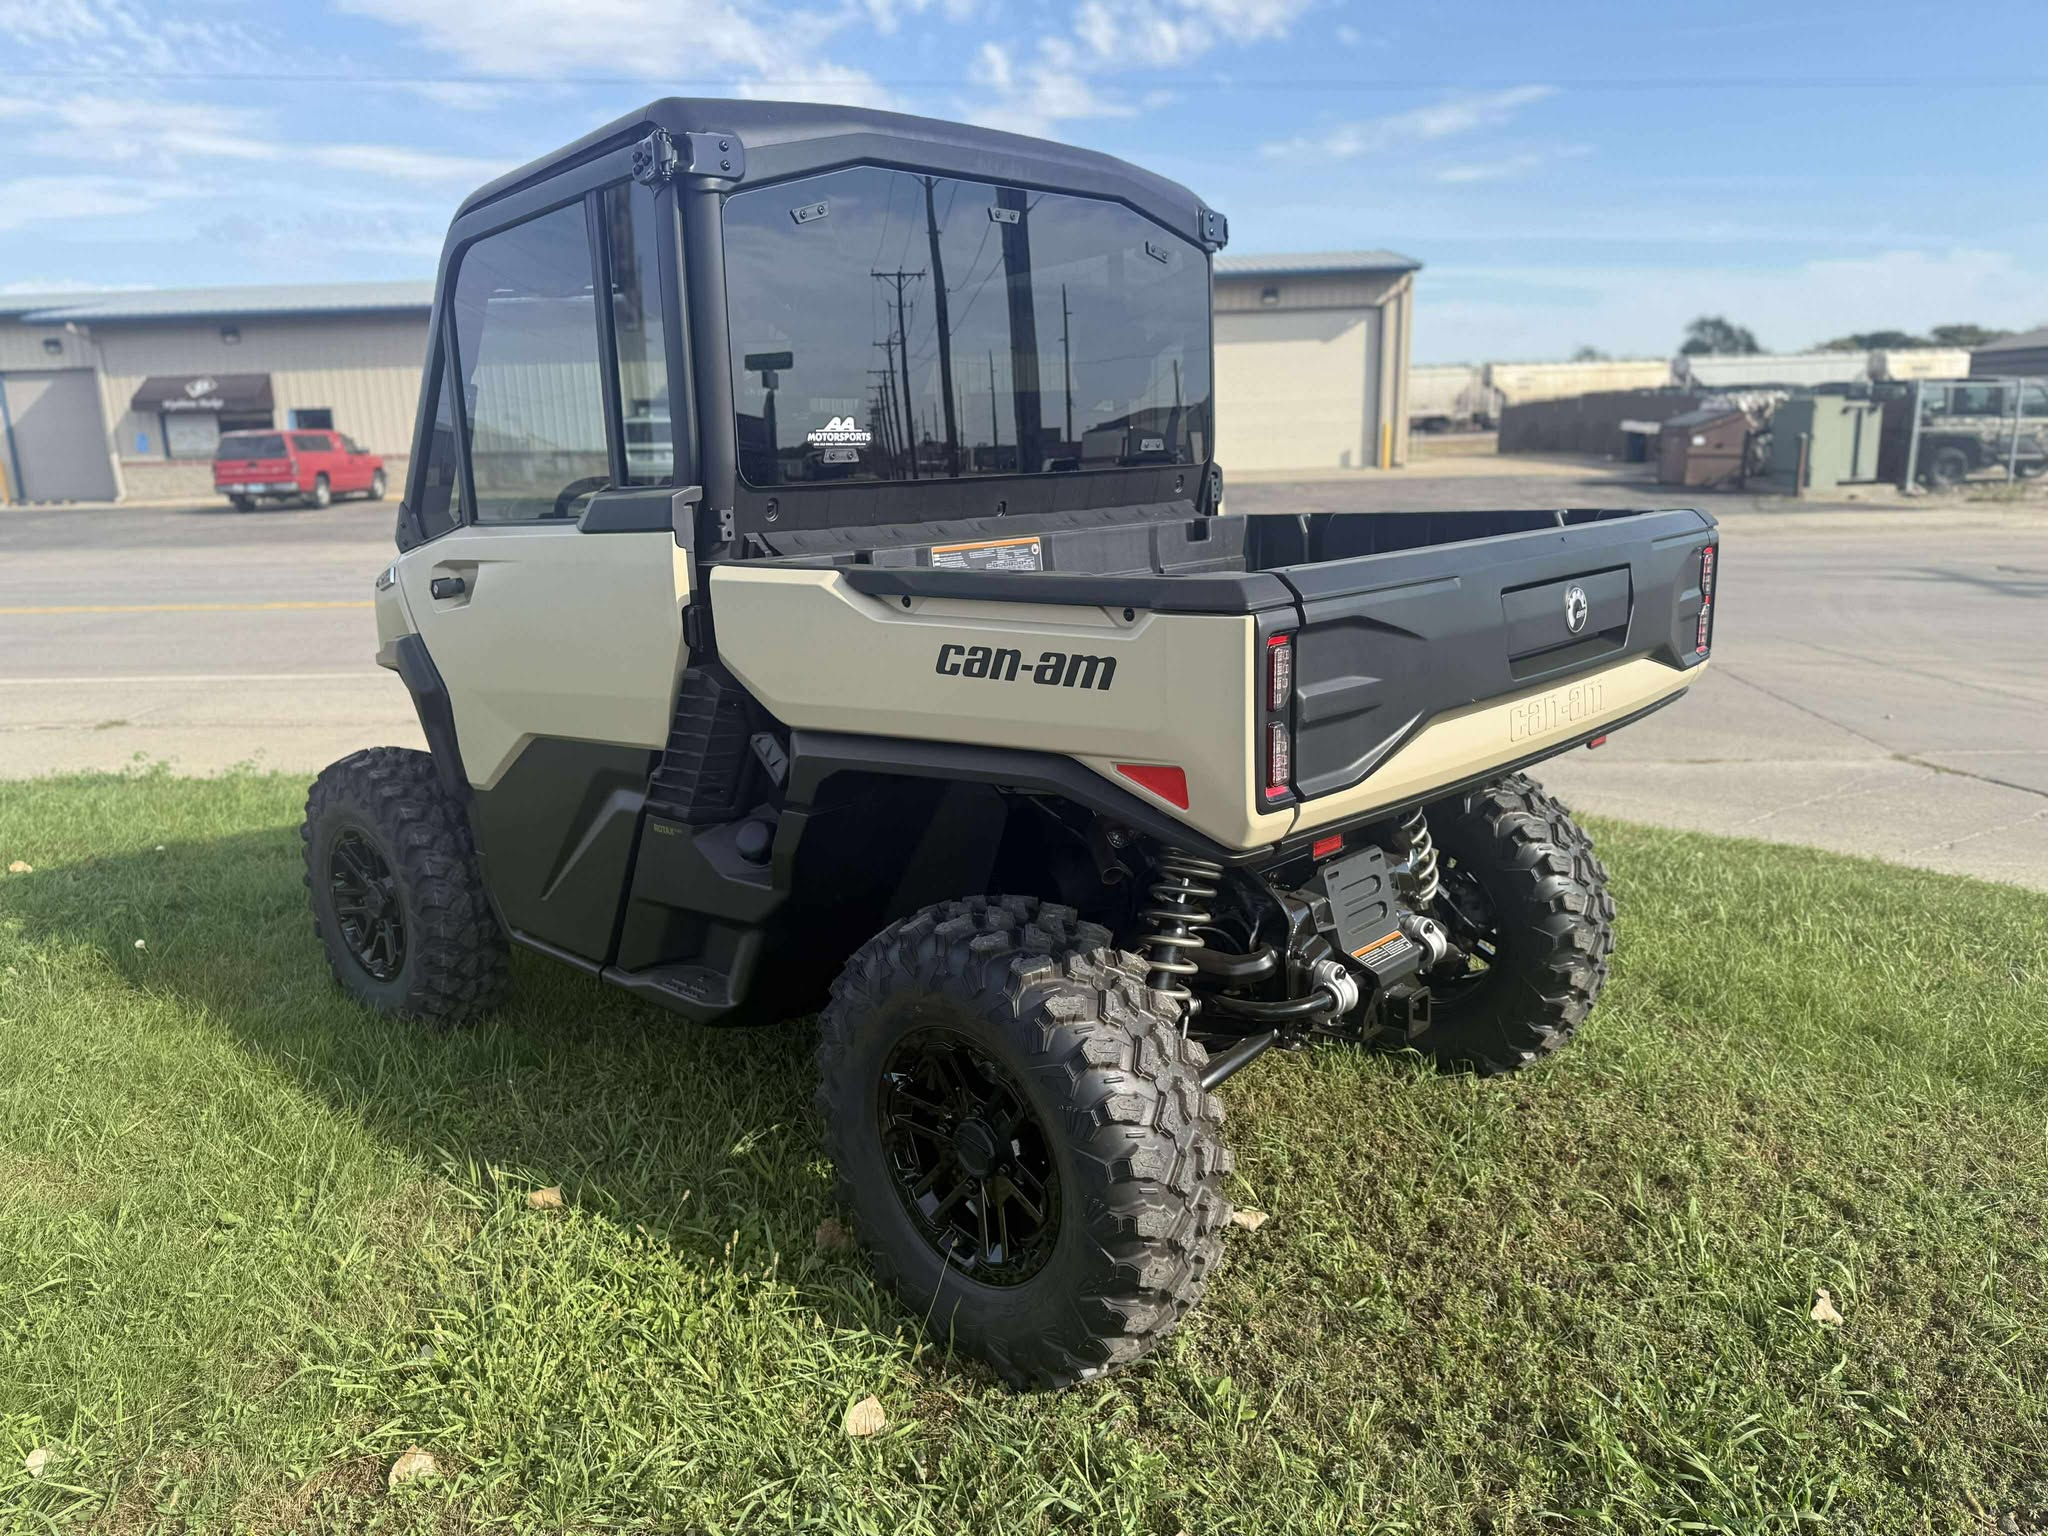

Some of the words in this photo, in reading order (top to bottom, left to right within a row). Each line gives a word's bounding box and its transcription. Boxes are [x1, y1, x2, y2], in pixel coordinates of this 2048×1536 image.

[807, 432, 871, 442] MOTORSPORTS
[935, 643, 1117, 691] can-am
[1509, 679, 1606, 742] can-am
